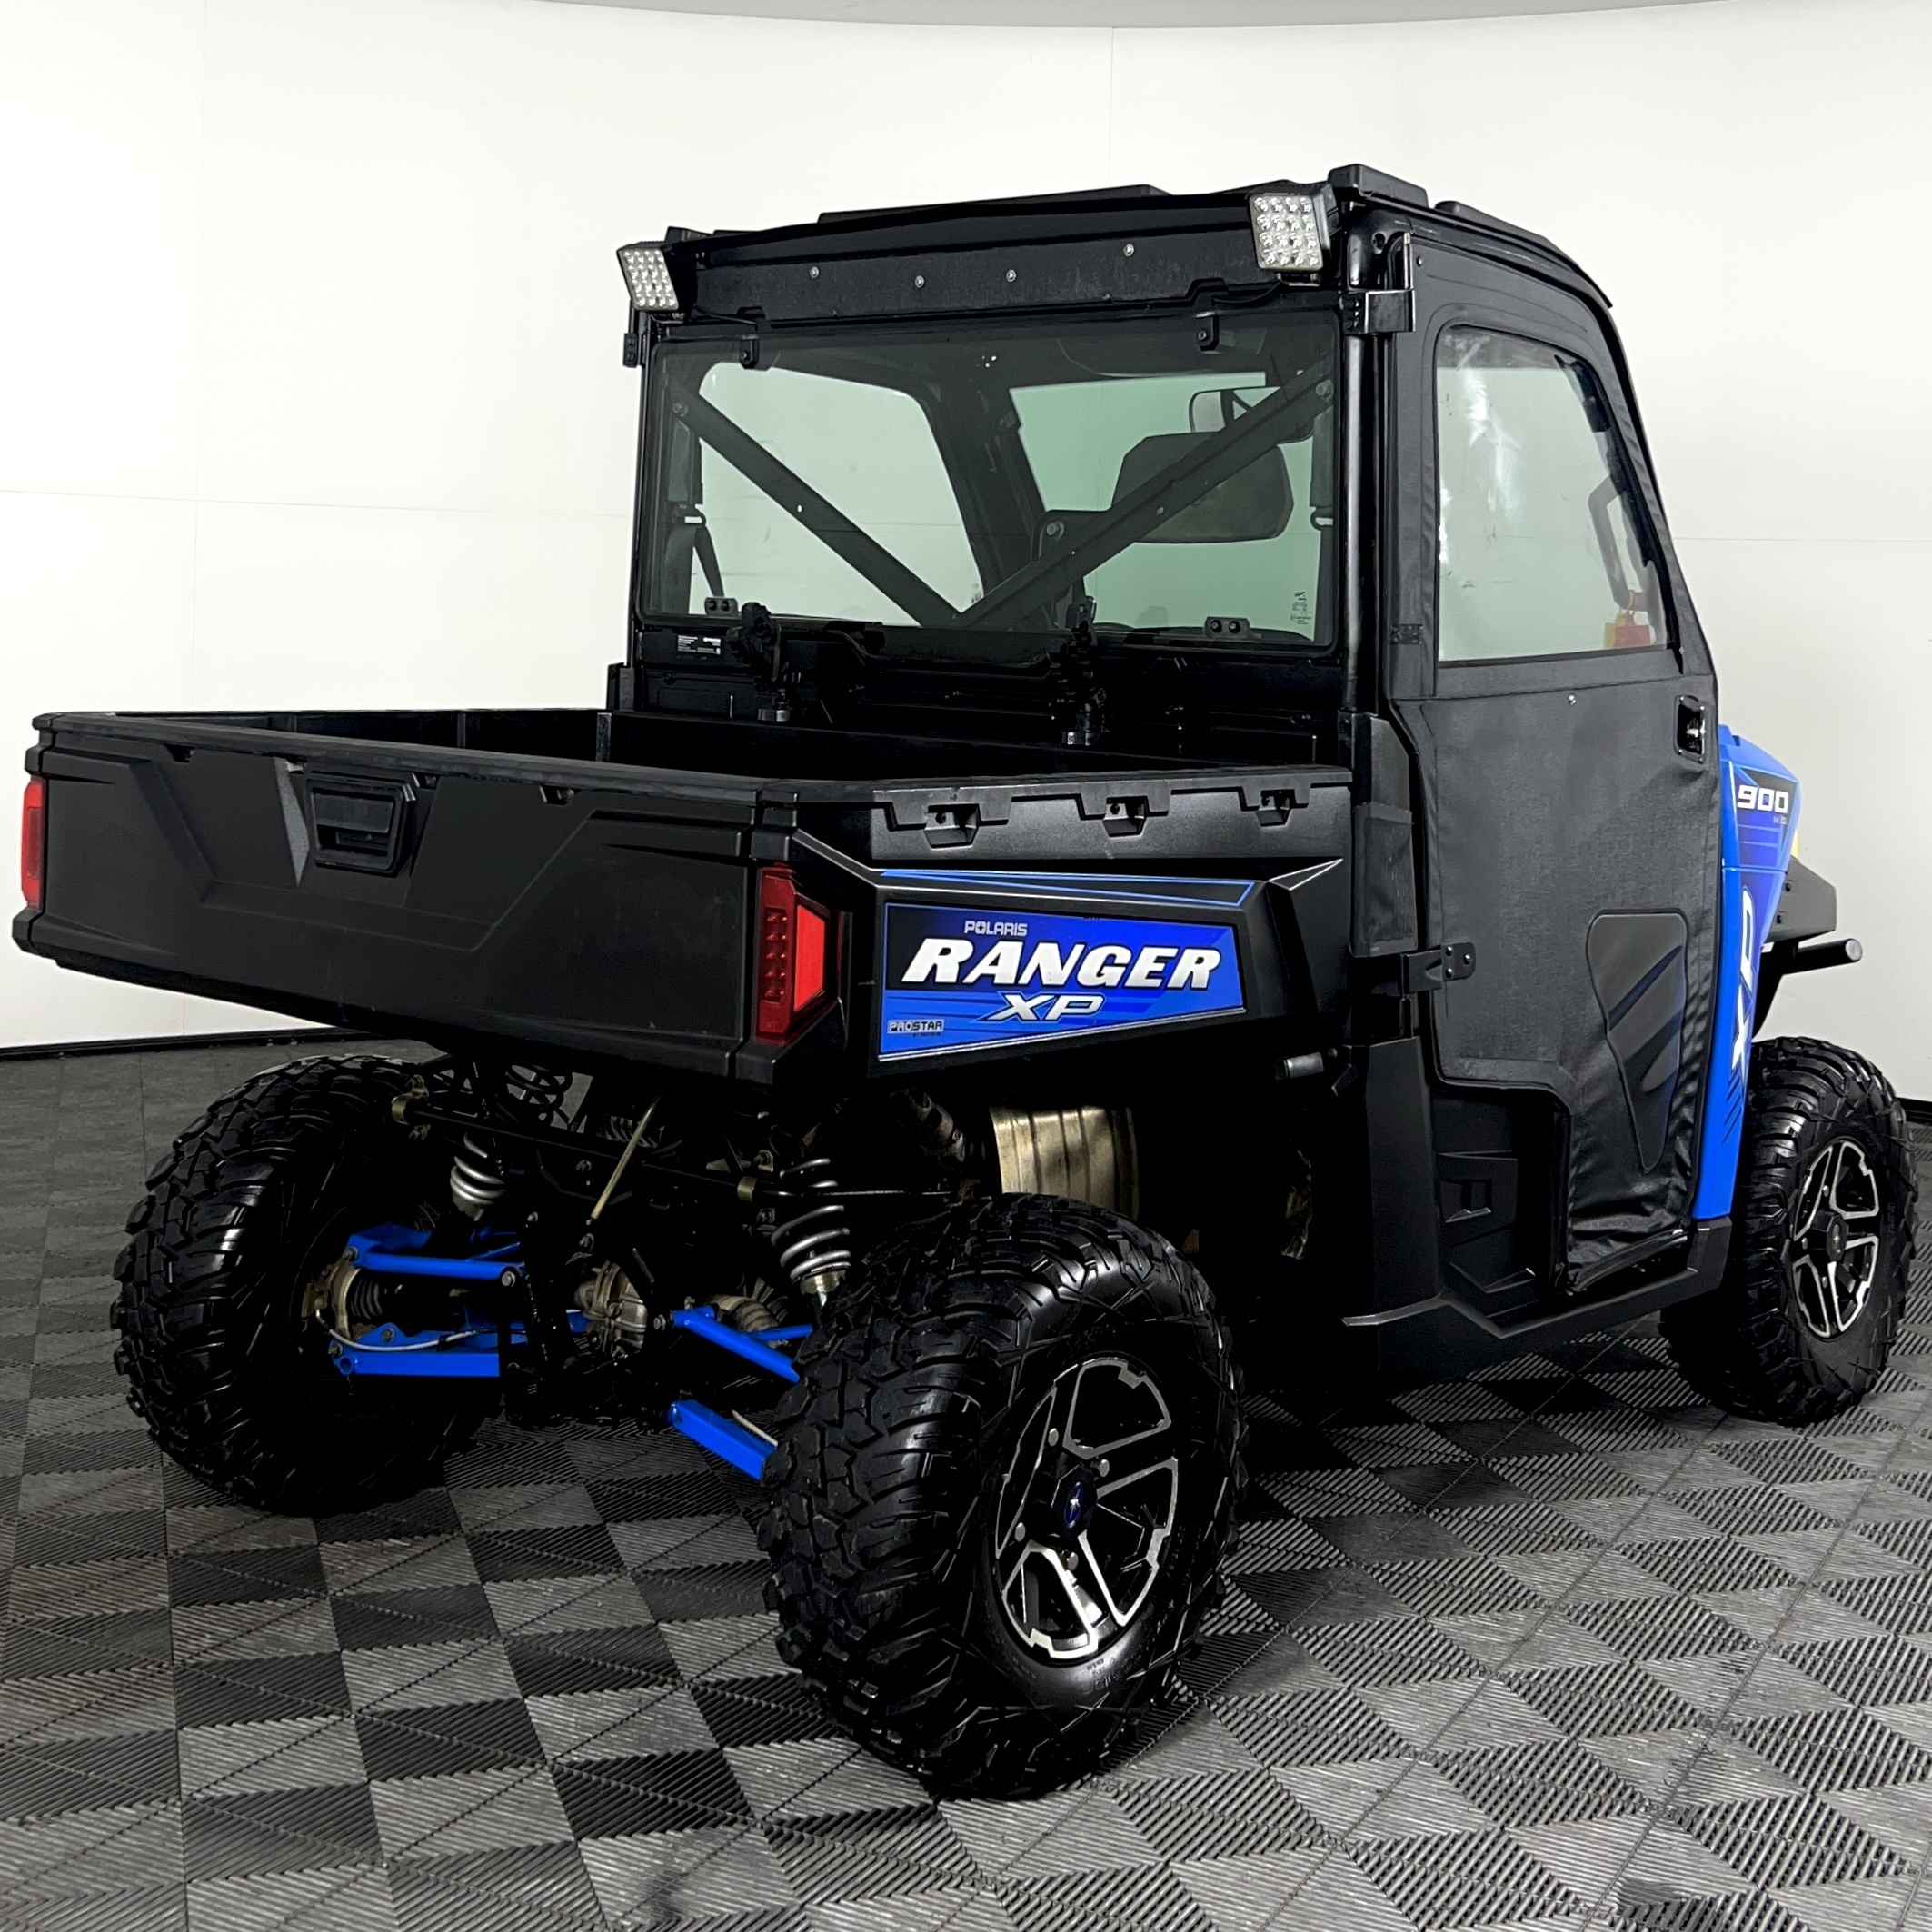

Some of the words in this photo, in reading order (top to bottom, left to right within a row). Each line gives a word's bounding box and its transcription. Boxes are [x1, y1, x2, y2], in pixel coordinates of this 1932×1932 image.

[1737, 784, 1789, 814] 900
[963, 920, 1029, 937] POLARIS
[901, 938, 1221, 990] RANGER
[985, 993, 1105, 1022] XP
[890, 1021, 943, 1032] PROSTAR
